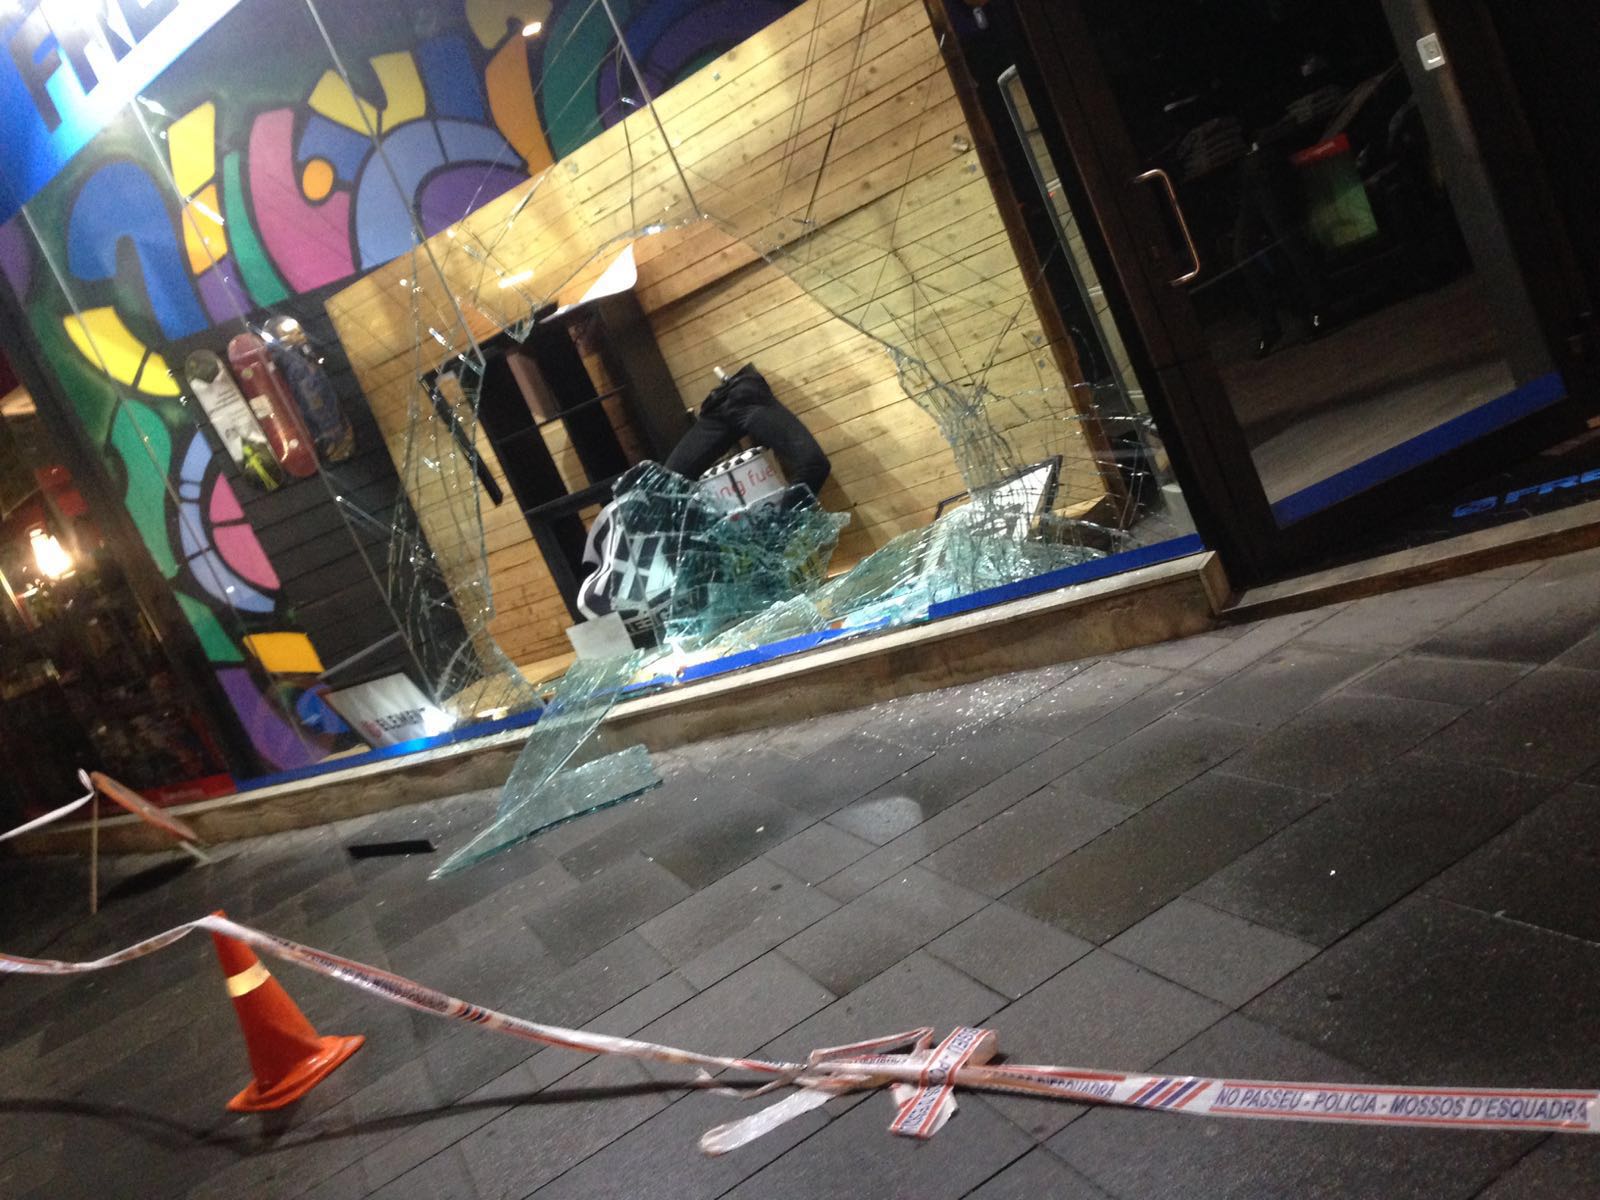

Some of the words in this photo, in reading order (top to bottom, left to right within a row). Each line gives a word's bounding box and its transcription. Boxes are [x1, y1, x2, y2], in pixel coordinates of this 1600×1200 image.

[1215, 1087, 1240, 1106] NO
[1240, 1088, 1304, 1110] PASSEU
[1311, 1092, 1377, 1113] POLICIA
[1389, 1095, 1464, 1117] MOSSOS
[1467, 1098, 1589, 1121] D'ESQUADRA
